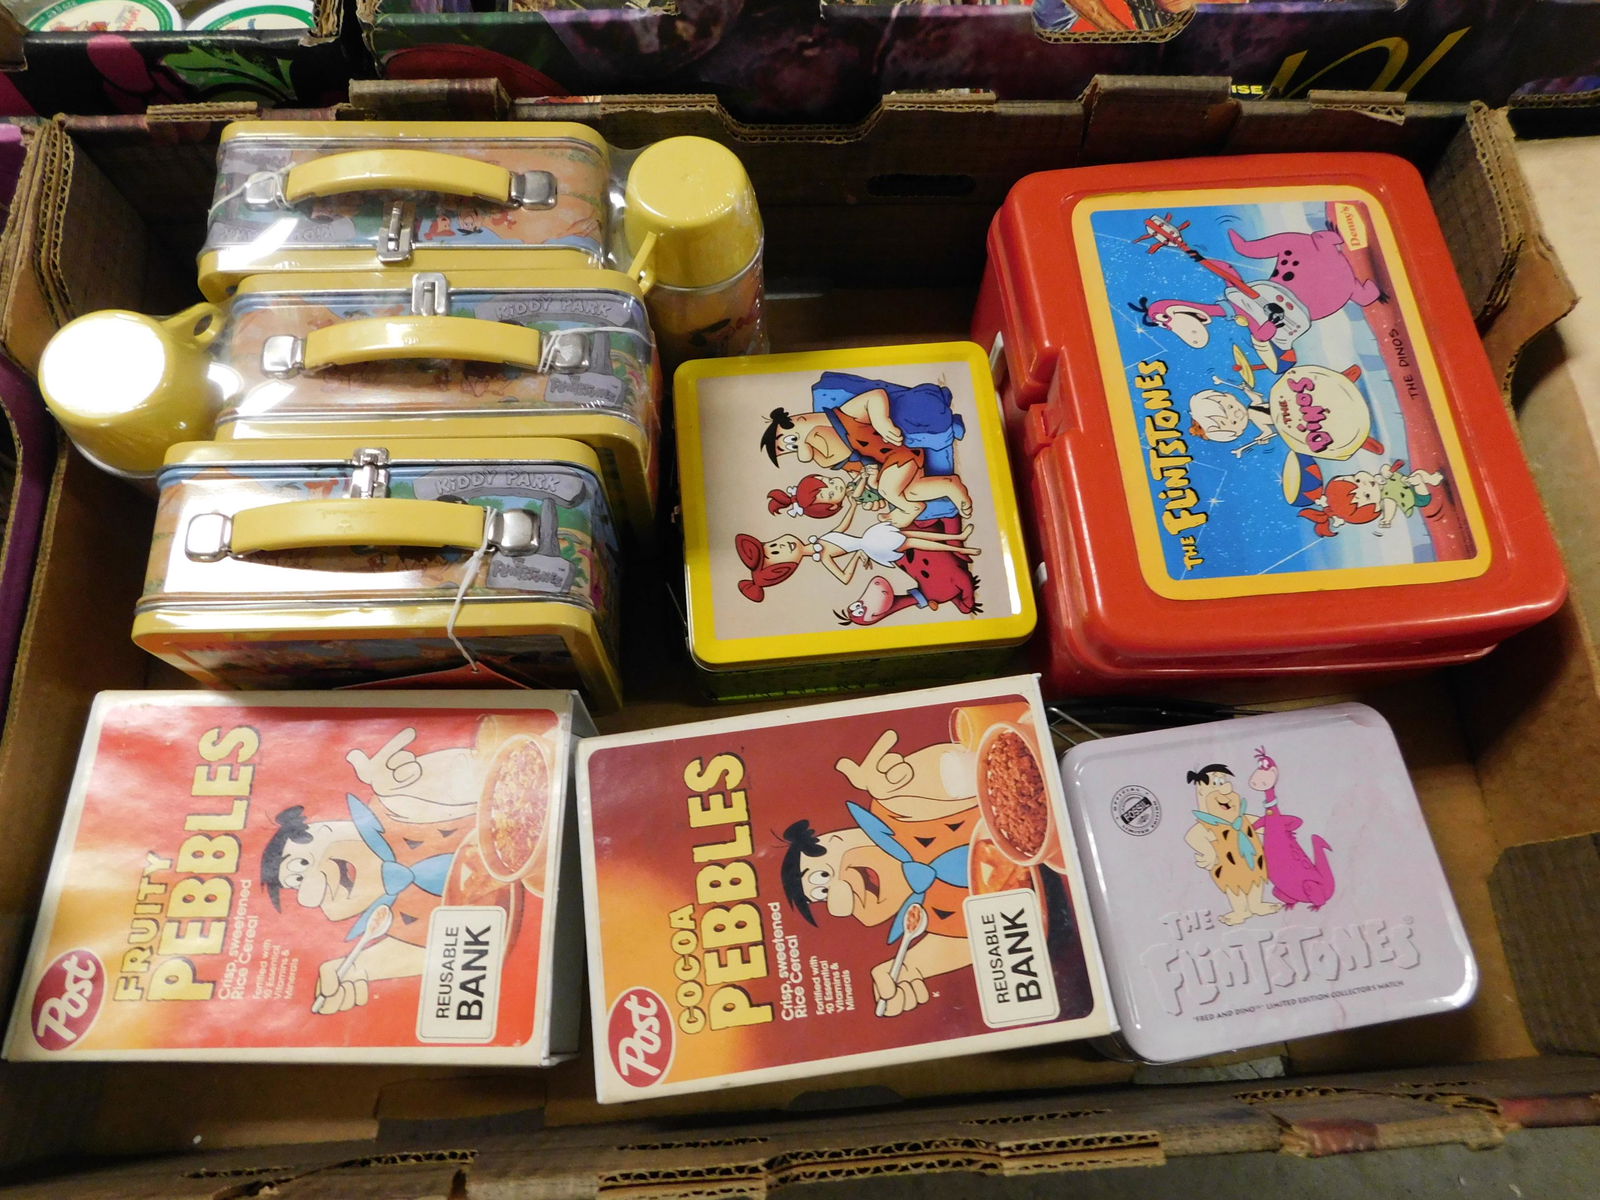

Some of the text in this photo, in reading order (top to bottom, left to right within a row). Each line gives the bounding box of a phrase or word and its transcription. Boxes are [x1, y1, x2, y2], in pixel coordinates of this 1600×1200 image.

[1342, 206, 1361, 247] Denny's
[560, 298, 612, 318] PARK
[1389, 329, 1419, 400] THE DINOS
[505, 471, 561, 493] PARK
[1180, 534, 1205, 571] THE
[1123, 800, 1151, 824] FOSSIL
[147, 724, 261, 1002] PEBBLES
[683, 751, 775, 1031] PEBBLES
[113, 851, 174, 1001] FRUITY
[218, 879, 252, 1000] Crisp, sweetened
[230, 915, 259, 999] Rice Cereal
[767, 902, 794, 1021] Crisp, sweetened
[981, 913, 1008, 1006] REUSABLE
[1001, 907, 1043, 1003] BANK
[1158, 910, 1214, 941] THE
[36, 954, 97, 1041] Post
[436, 926, 459, 1019] REUSABLE
[456, 924, 491, 1021] BANK
[668, 903, 707, 1035] COCOA
[785, 935, 808, 1018] Rice Cereal
[809, 955, 825, 1015] Fortified with
[819, 960, 833, 1001] Essential
[830, 962, 845, 1013] Vitamins &
[842, 969, 855, 1011] Minerals
[1217, 1009, 1233, 1019] AND
[1266, 998, 1297, 1010] LIMITED
[1298, 992, 1330, 1004] EDITION
[618, 994, 662, 1077] Post
